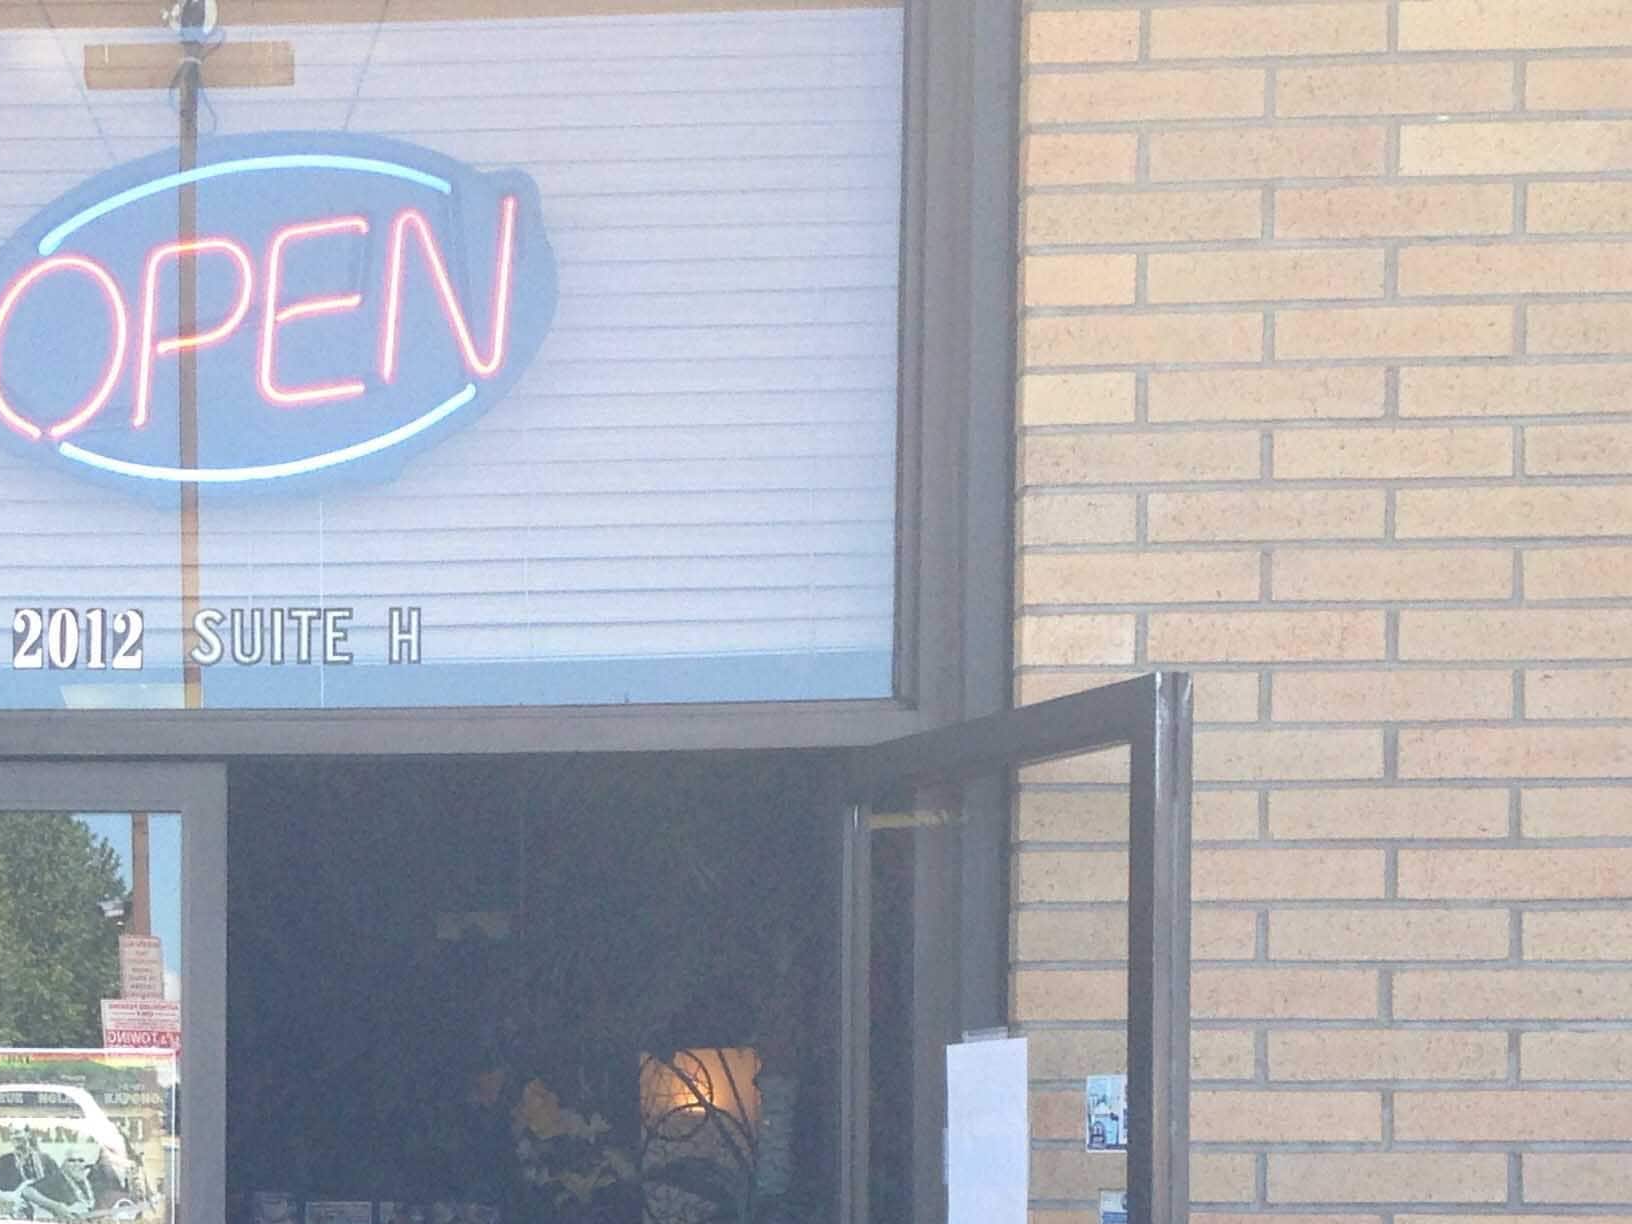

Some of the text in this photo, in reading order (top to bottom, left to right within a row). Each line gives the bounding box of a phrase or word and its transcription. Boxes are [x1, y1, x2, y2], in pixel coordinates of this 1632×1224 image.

[12, 607, 423, 670] 2012 SUITE H
